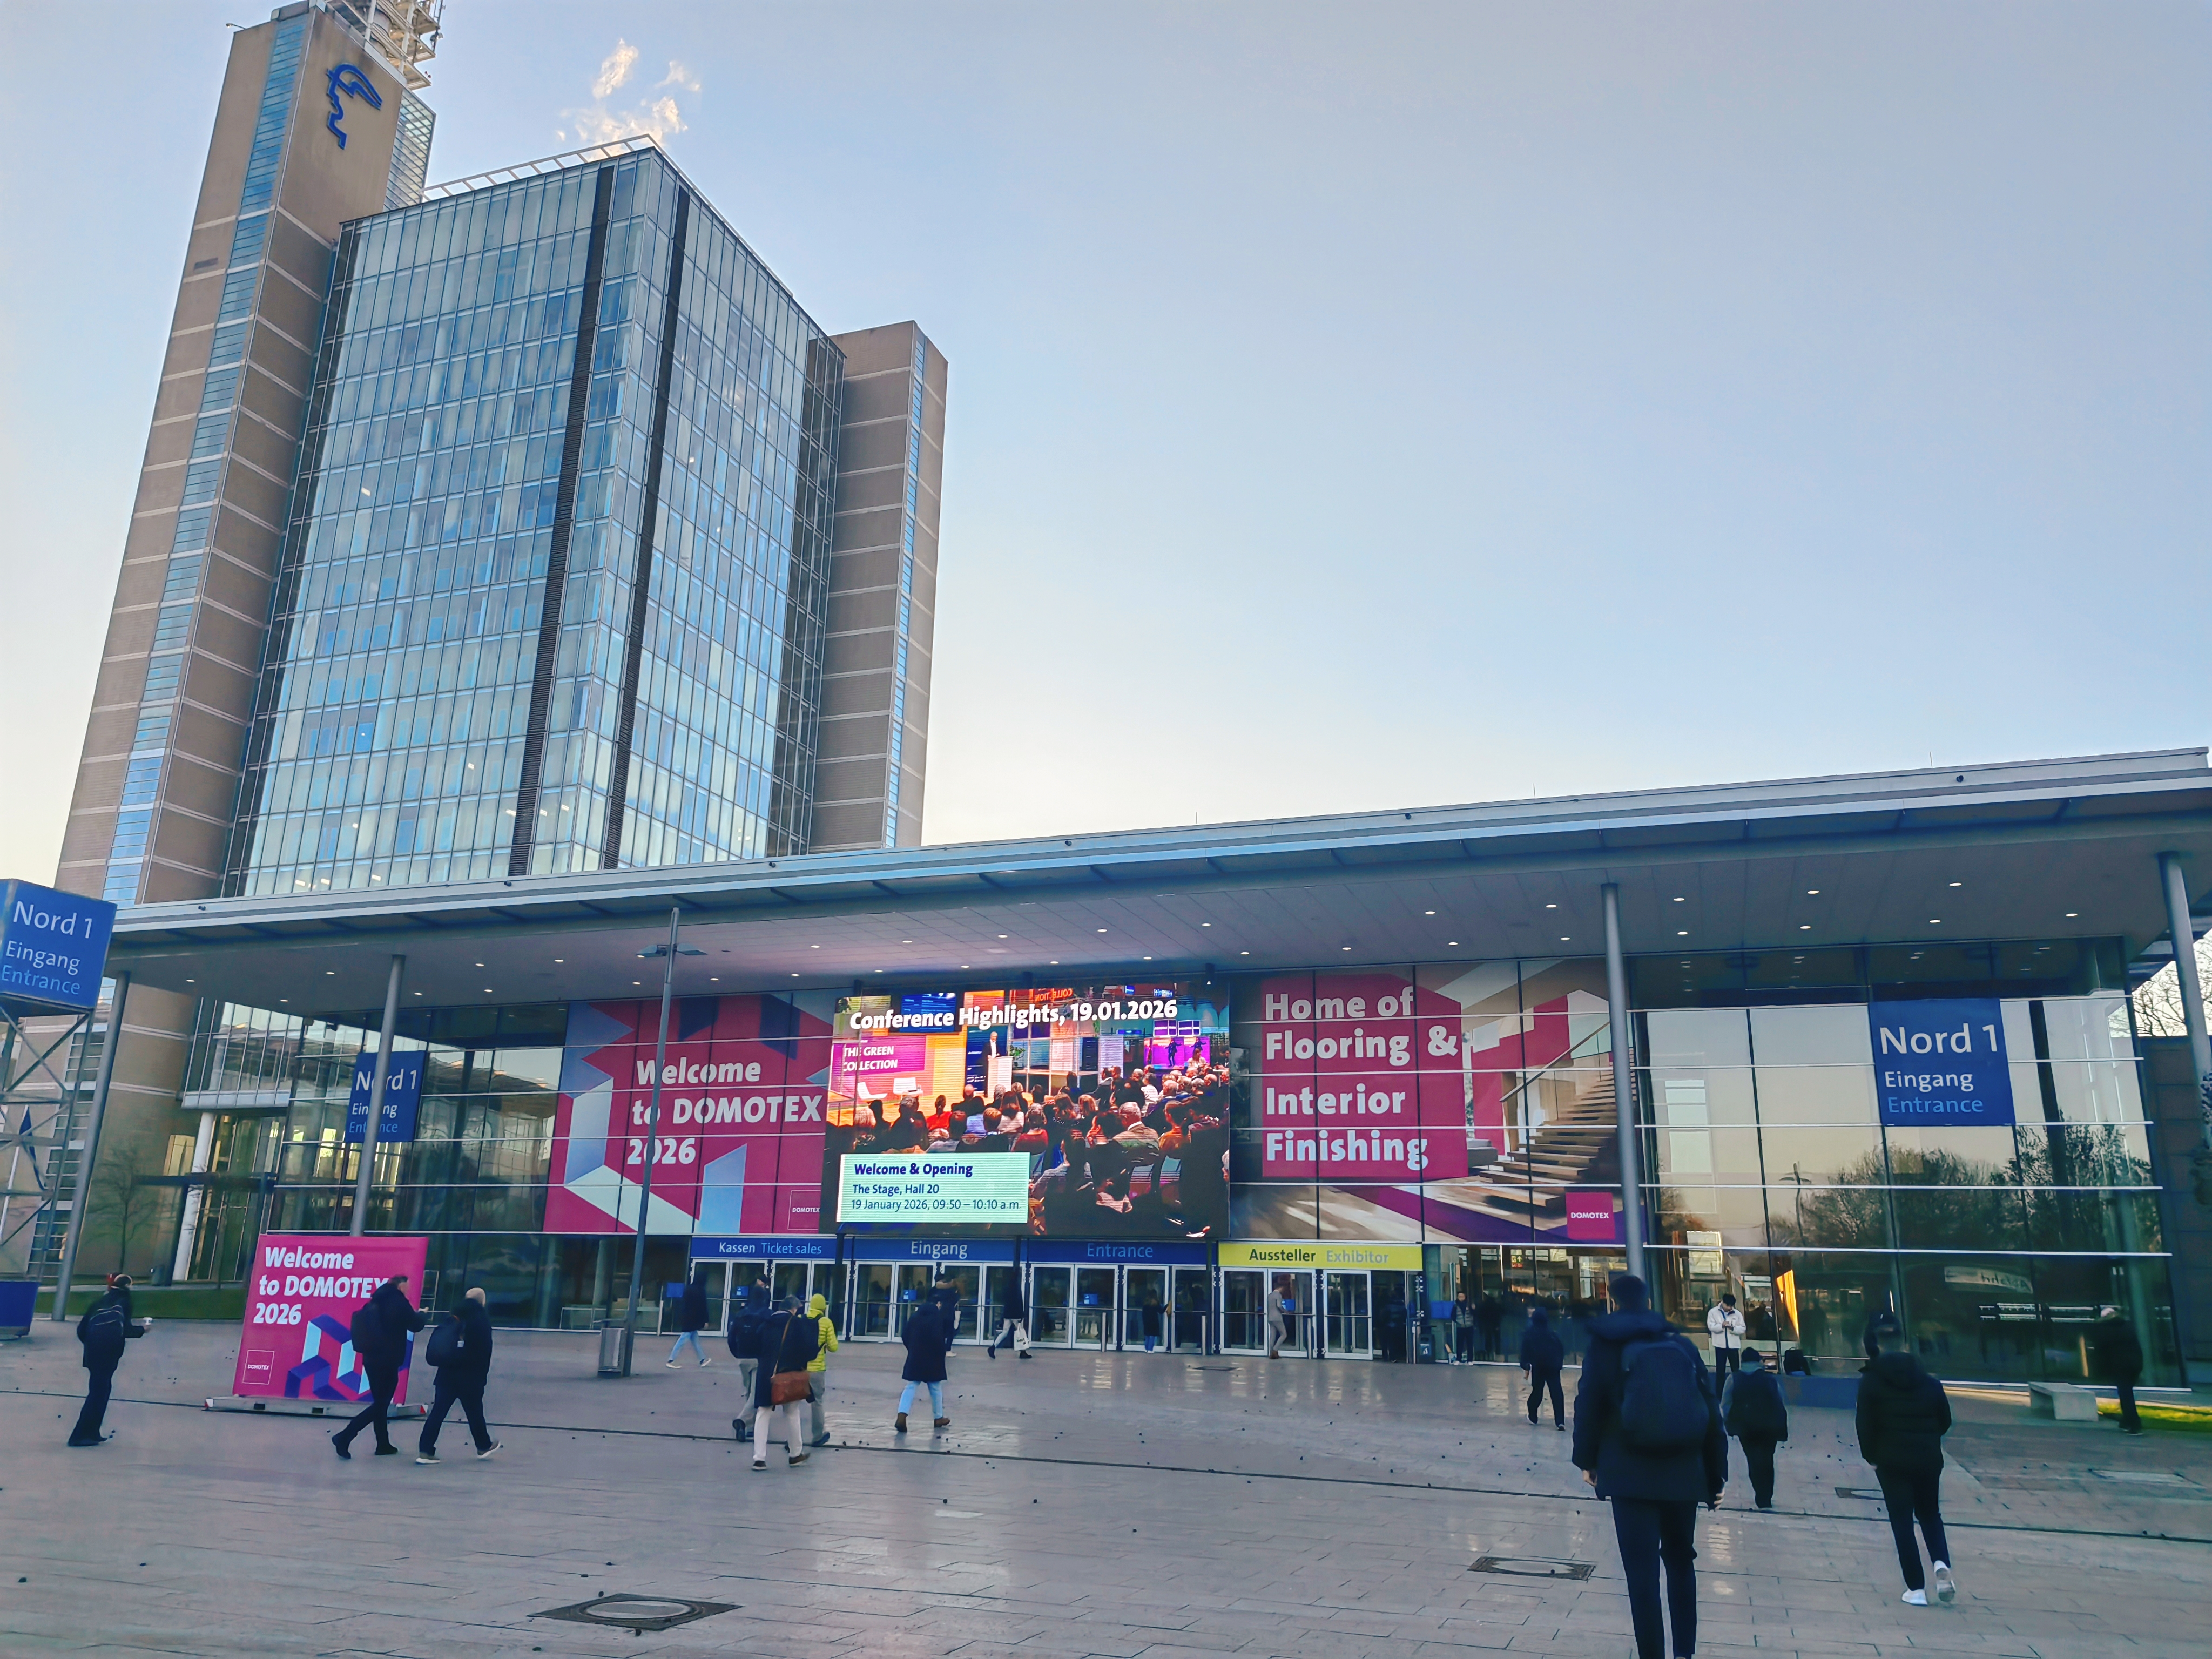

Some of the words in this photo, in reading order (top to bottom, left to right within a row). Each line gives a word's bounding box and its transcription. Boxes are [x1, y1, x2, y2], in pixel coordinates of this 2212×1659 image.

[13, 901, 77, 935] Nord
[85, 918, 92, 939] 1
[6, 940, 80, 975] Eingang
[1, 965, 80, 995] Entrance
[1266, 993, 1366, 1020] Home
[1377, 986, 1414, 1017] of
[849, 1009, 954, 1029] Conference
[959, 1003, 1065, 1030] Highlights,
[1070, 999, 1178, 1021] 19.01.2026
[1266, 1028, 1410, 1066] Flooring
[1427, 1025, 1459, 1057] &
[1880, 1023, 1972, 1054] Nord
[1982, 1024, 1998, 1052] 1
[863, 1046, 894, 1056] GREEN
[355, 1068, 404, 1091] Nrd
[410, 1069, 417, 1090] 1
[636, 1056, 761, 1085] Welcome
[1885, 1070, 1974, 1092] Eingang
[352, 1102, 398, 1118] Einng
[632, 1099, 661, 1125] to
[672, 1095, 823, 1124] DOMOTEX
[1266, 1083, 1406, 1115] Interior
[1887, 1096, 1984, 1113] Entrance
[349, 1121, 398, 1134] Entnce
[626, 1137, 696, 1165] 2026
[1267, 1129, 1428, 1171] Finishing
[854, 1163, 906, 1175] Welcome
[909, 1163, 920, 1175] &
[923, 1162, 973, 1177] Opening
[853, 1184, 870, 1194] The
[873, 1184, 902, 1197] Stage,
[905, 1184, 924, 1194] Hall
[927, 1184, 939, 1194] 20
[852, 1199, 861, 1210] 19
[864, 1199, 901, 1212] January
[904, 1199, 930, 1211] 2026,
[933, 1199, 961, 1210] 09:50
[973, 1199, 997, 1210] 10:10
[1000, 1201, 1022, 1210] a.m.
[265, 1246, 354, 1270] Welcome
[719, 1242, 756, 1253] Kassen
[761, 1242, 793, 1255] Ticket
[795, 1242, 822, 1255] sales
[911, 1240, 968, 1259] Eingang
[1087, 1243, 1153, 1258] Entrance
[1249, 1249, 1316, 1262] Aussteller
[1326, 1250, 1388, 1264] Exhibitor
[259, 1274, 280, 1296] to
[253, 1303, 302, 1325] 2026
